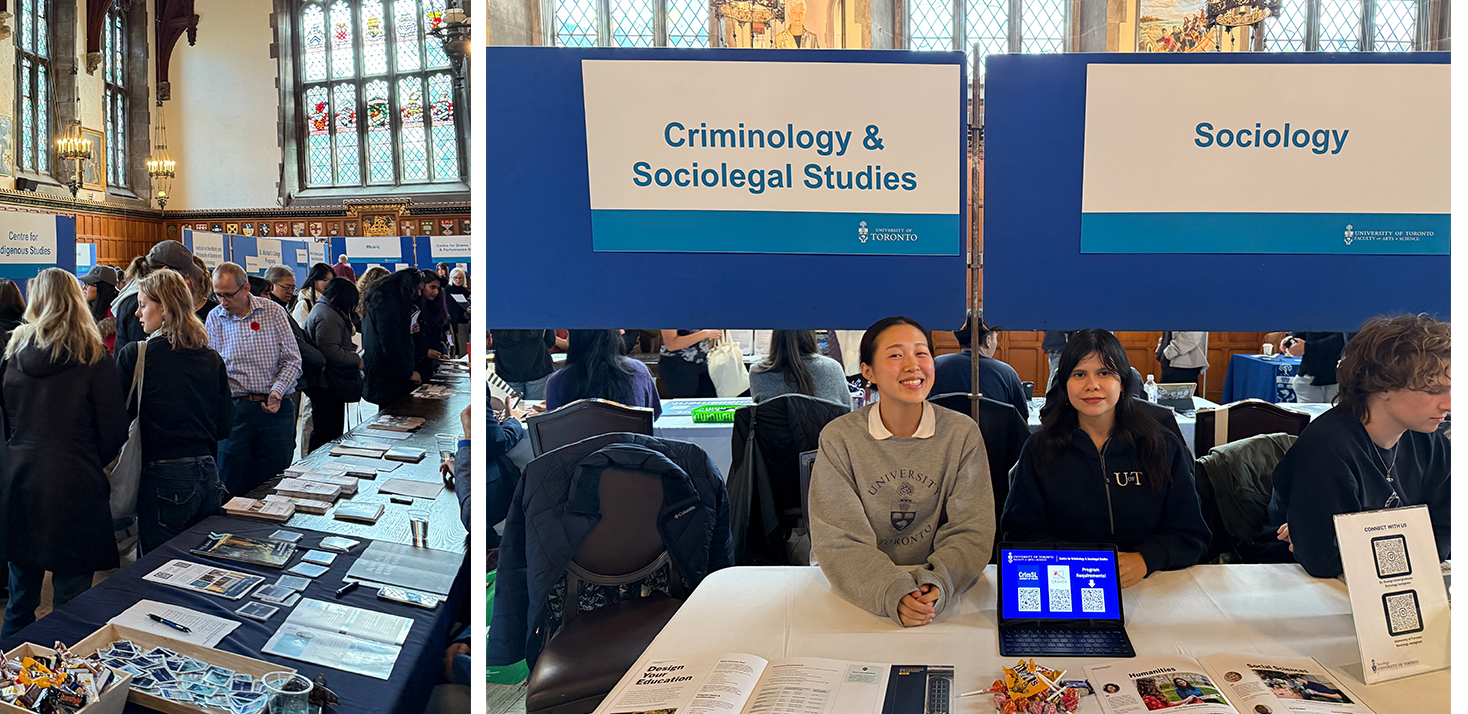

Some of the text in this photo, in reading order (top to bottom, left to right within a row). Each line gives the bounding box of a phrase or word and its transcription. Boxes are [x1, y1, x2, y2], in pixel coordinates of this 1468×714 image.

[664, 122, 884, 156] Criminology &
[1194, 122, 1349, 155] Sociology
[632, 162, 917, 194] Sociolegal Studies
[8, 231, 38, 242] Centre for
[870, 233, 918, 241] TORONTO
[30, 246, 51, 256] Studies
[868, 470, 940, 495] UNIVERSITY
[878, 524, 932, 546] TORONTO
[1129, 667, 1176, 679] Humanities
[1272, 665, 1310, 674] Sciences
[636, 676, 692, 685] Education
